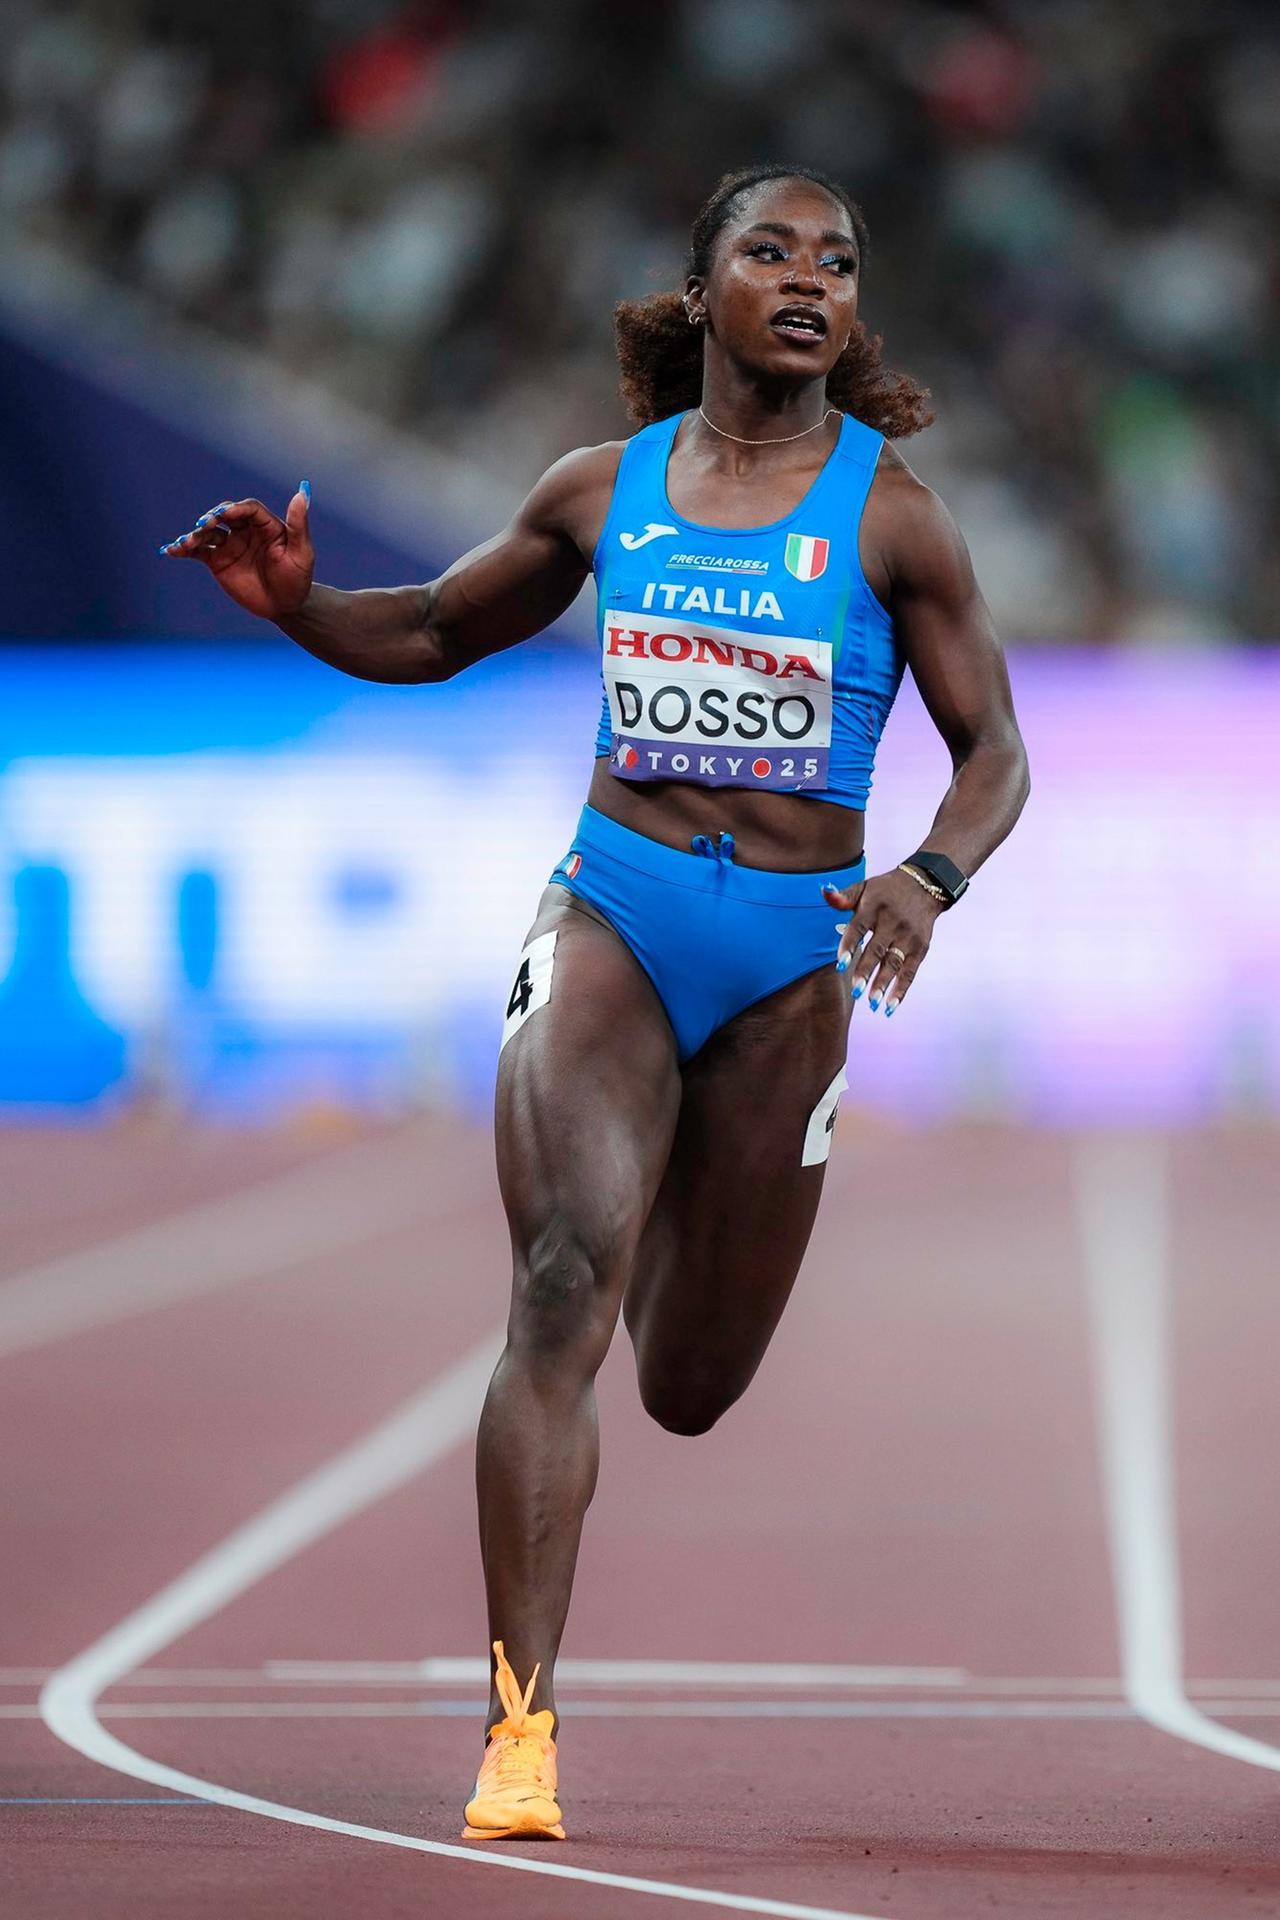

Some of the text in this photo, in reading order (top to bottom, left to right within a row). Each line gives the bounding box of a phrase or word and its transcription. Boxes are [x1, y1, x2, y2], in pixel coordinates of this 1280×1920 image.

[669, 554, 769, 570] FRECCIAROSSA
[642, 583, 784, 621] ITALIA
[607, 627, 825, 682] HONDA
[615, 682, 815, 740] DOSSO
[780, 758, 818, 777] 25
[507, 957, 534, 1020] 4
